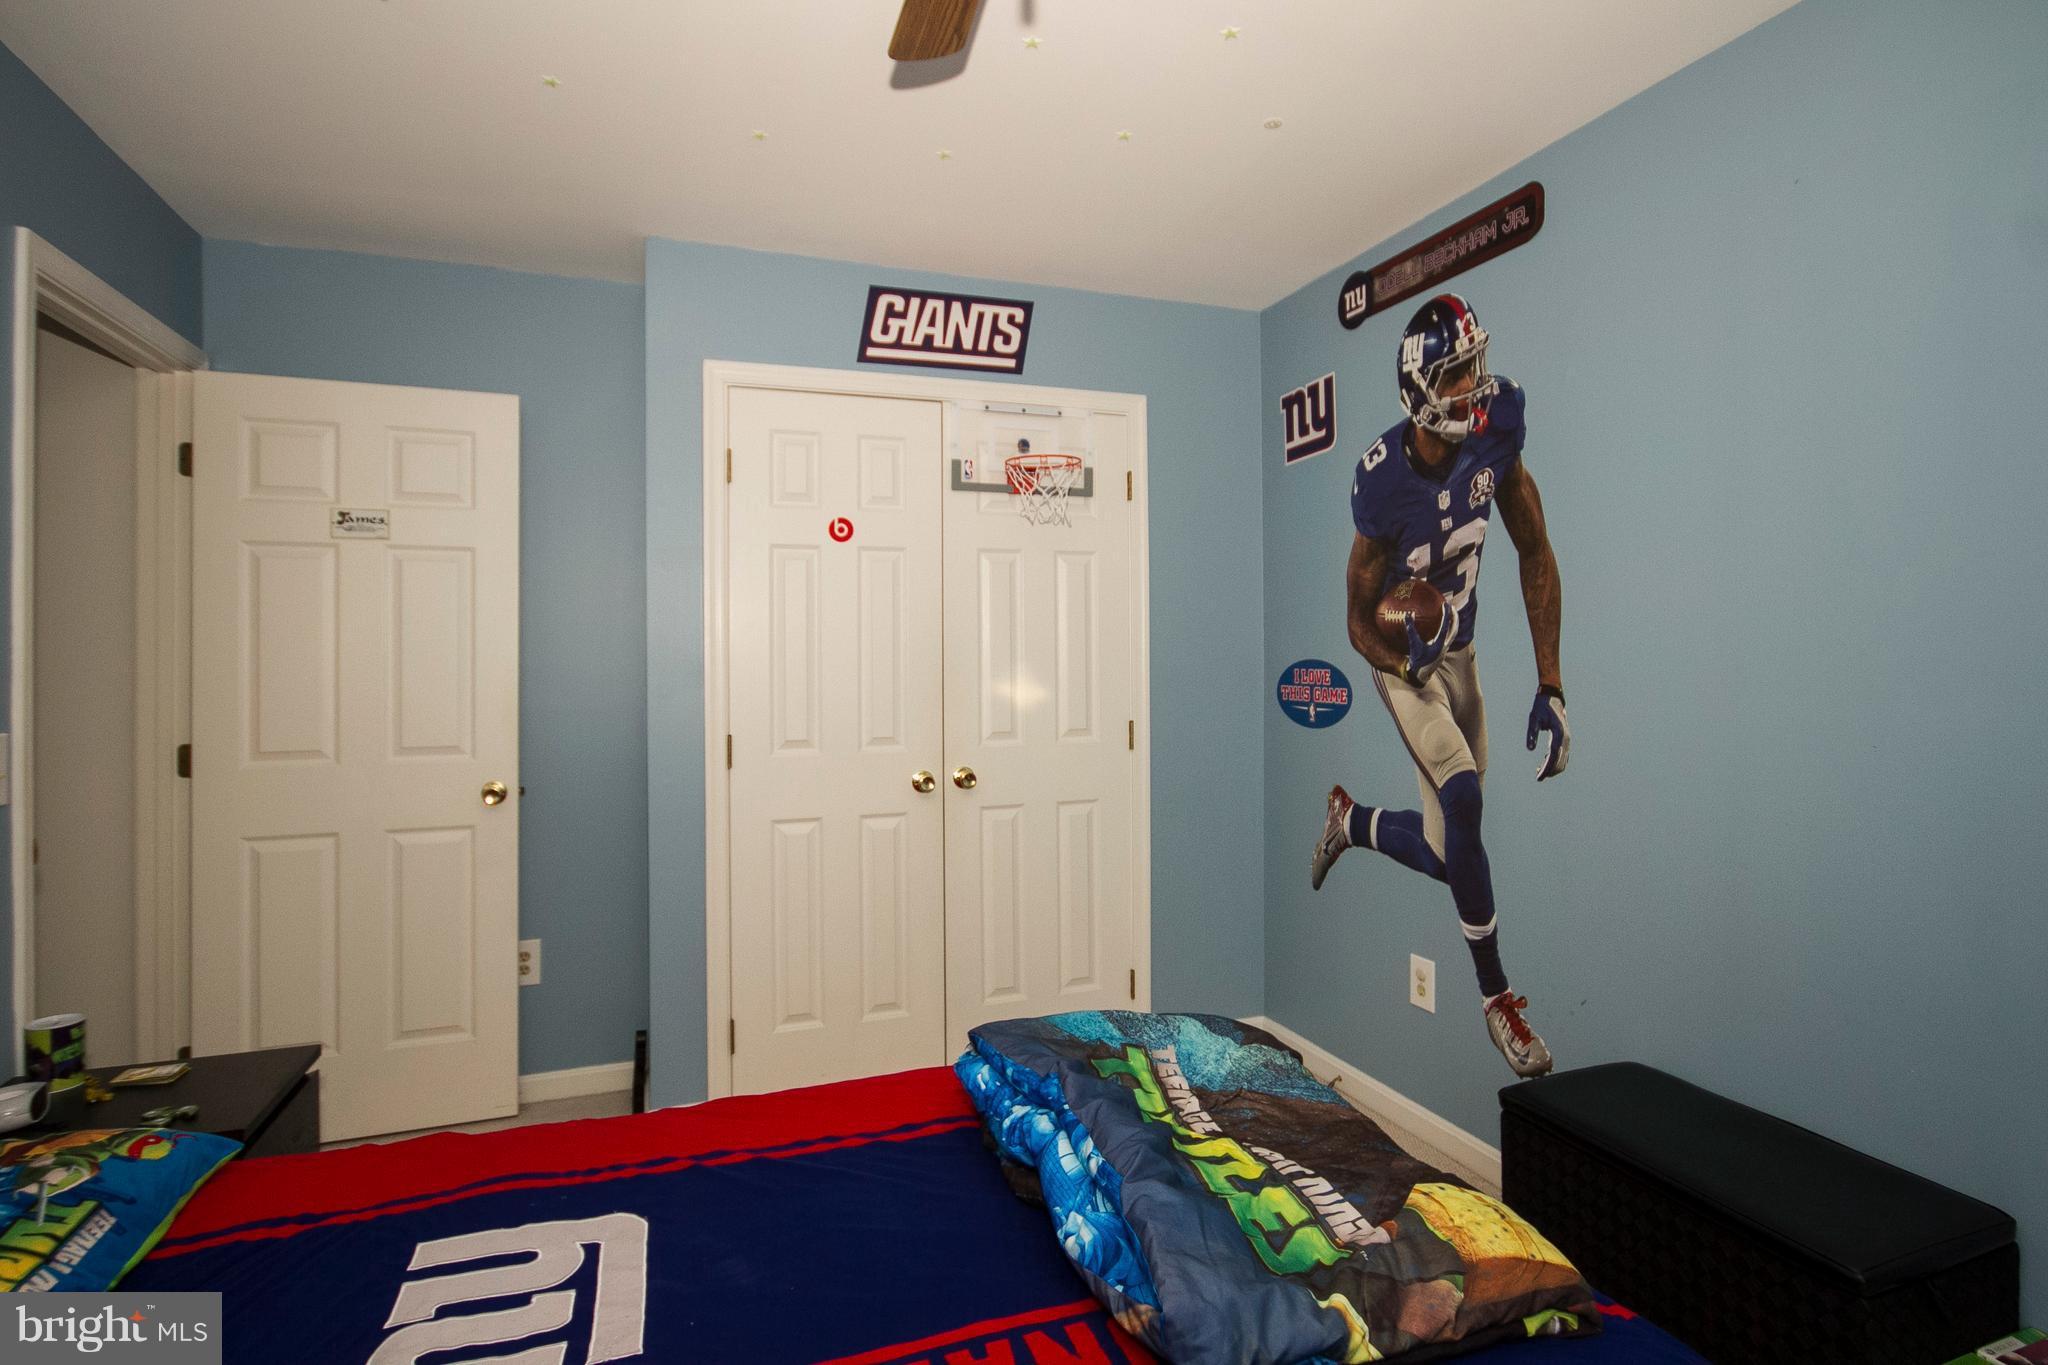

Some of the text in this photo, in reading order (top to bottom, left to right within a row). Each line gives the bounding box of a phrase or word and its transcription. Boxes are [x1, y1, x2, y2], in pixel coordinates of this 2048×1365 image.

[1424, 220, 1498, 272] BECKHAM
[870, 293, 1025, 354] GIANTS
[1281, 685, 1348, 704] THIS GAME
[1294, 668, 1331, 686] I LOVE
